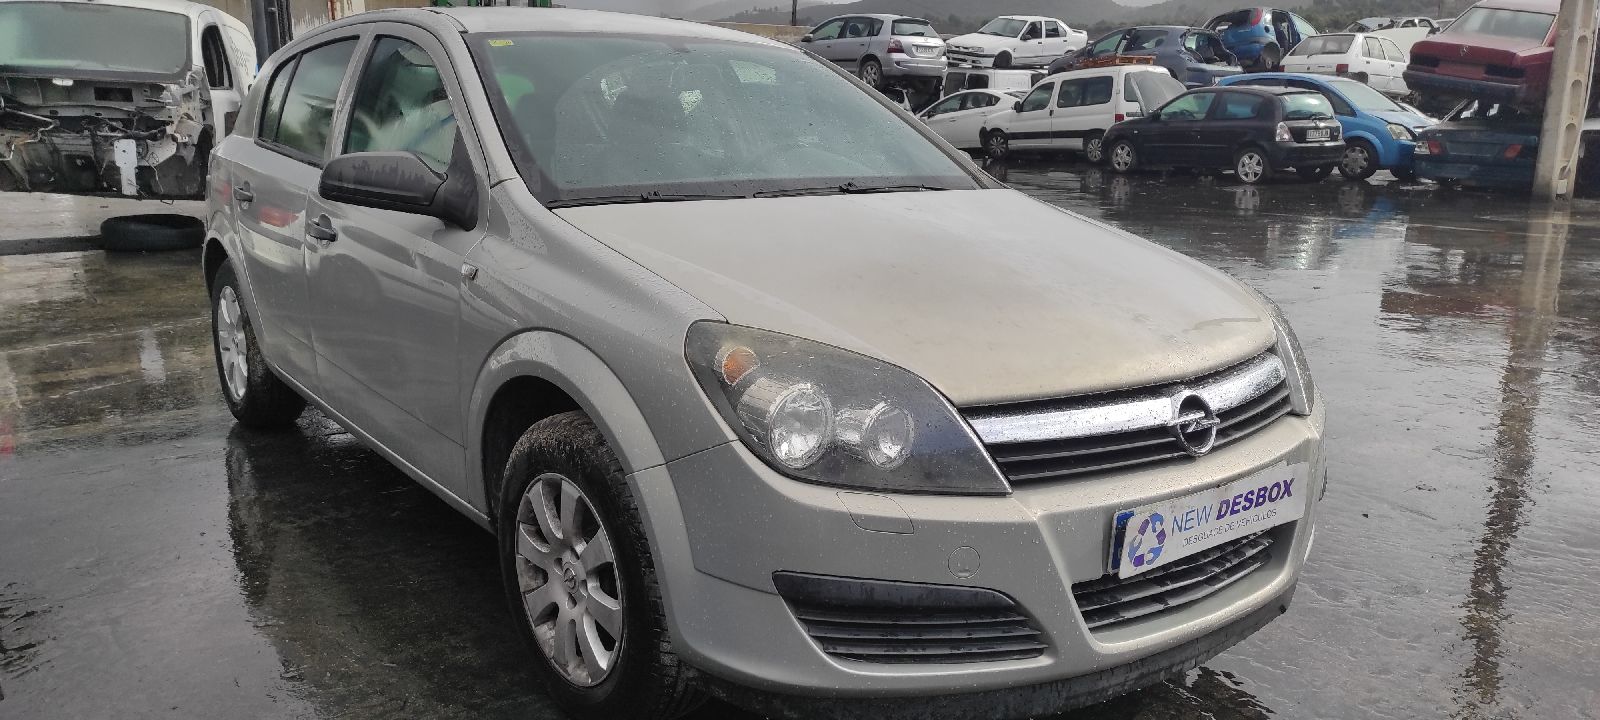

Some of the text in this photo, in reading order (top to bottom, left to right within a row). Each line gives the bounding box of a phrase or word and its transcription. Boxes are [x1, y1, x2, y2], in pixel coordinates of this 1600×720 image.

[1172, 478, 1295, 536] NEW DESBOX
[1183, 525, 1223, 547] DESGUACE
[1224, 521, 1235, 533] DE
